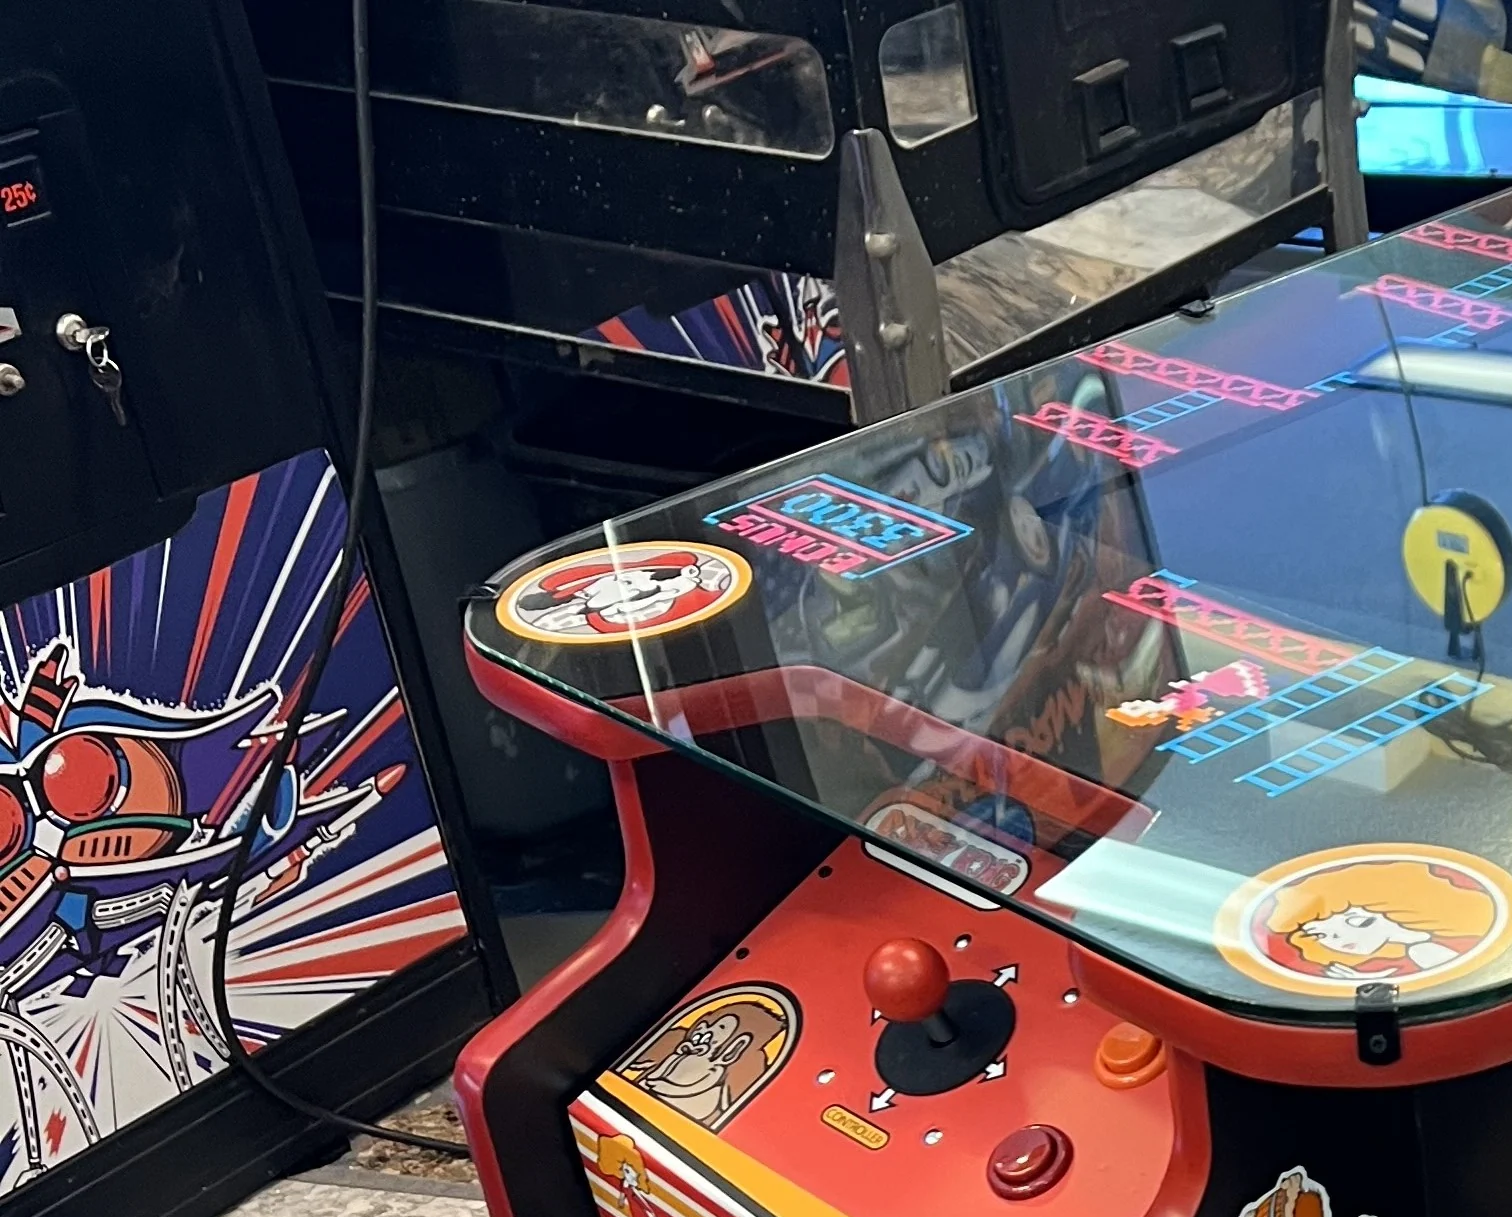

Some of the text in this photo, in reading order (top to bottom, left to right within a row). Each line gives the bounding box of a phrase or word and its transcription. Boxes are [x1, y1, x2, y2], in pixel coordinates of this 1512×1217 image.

[0, 181, 37, 213] 25¢
[718, 513, 868, 573] BONUS
[824, 1107, 885, 1145] CONTROLLER
